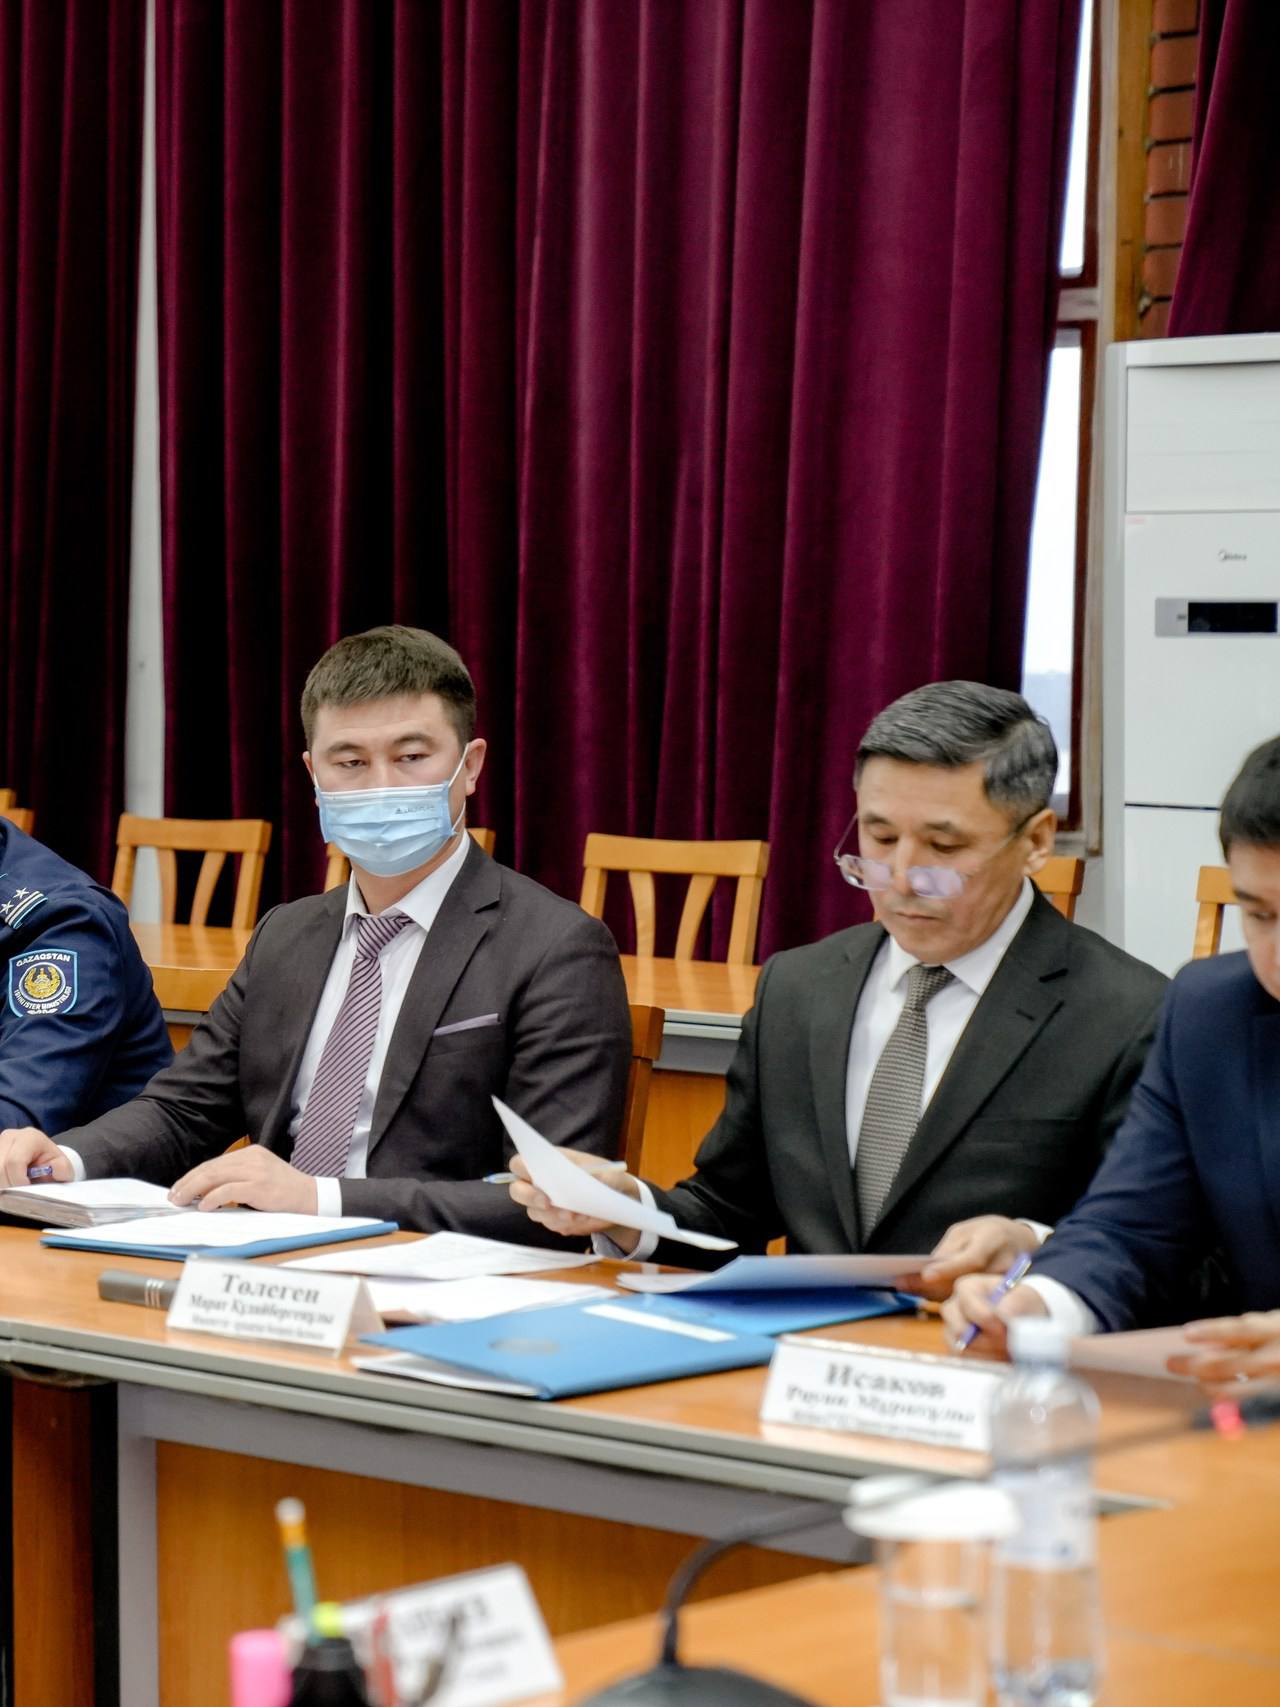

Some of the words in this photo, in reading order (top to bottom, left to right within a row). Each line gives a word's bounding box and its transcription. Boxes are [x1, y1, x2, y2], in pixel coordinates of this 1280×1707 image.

[16, 953, 71, 967] QAZAQSTAN
[222, 1273, 321, 1305] Төлеген
[825, 1362, 947, 1400] Исаков
